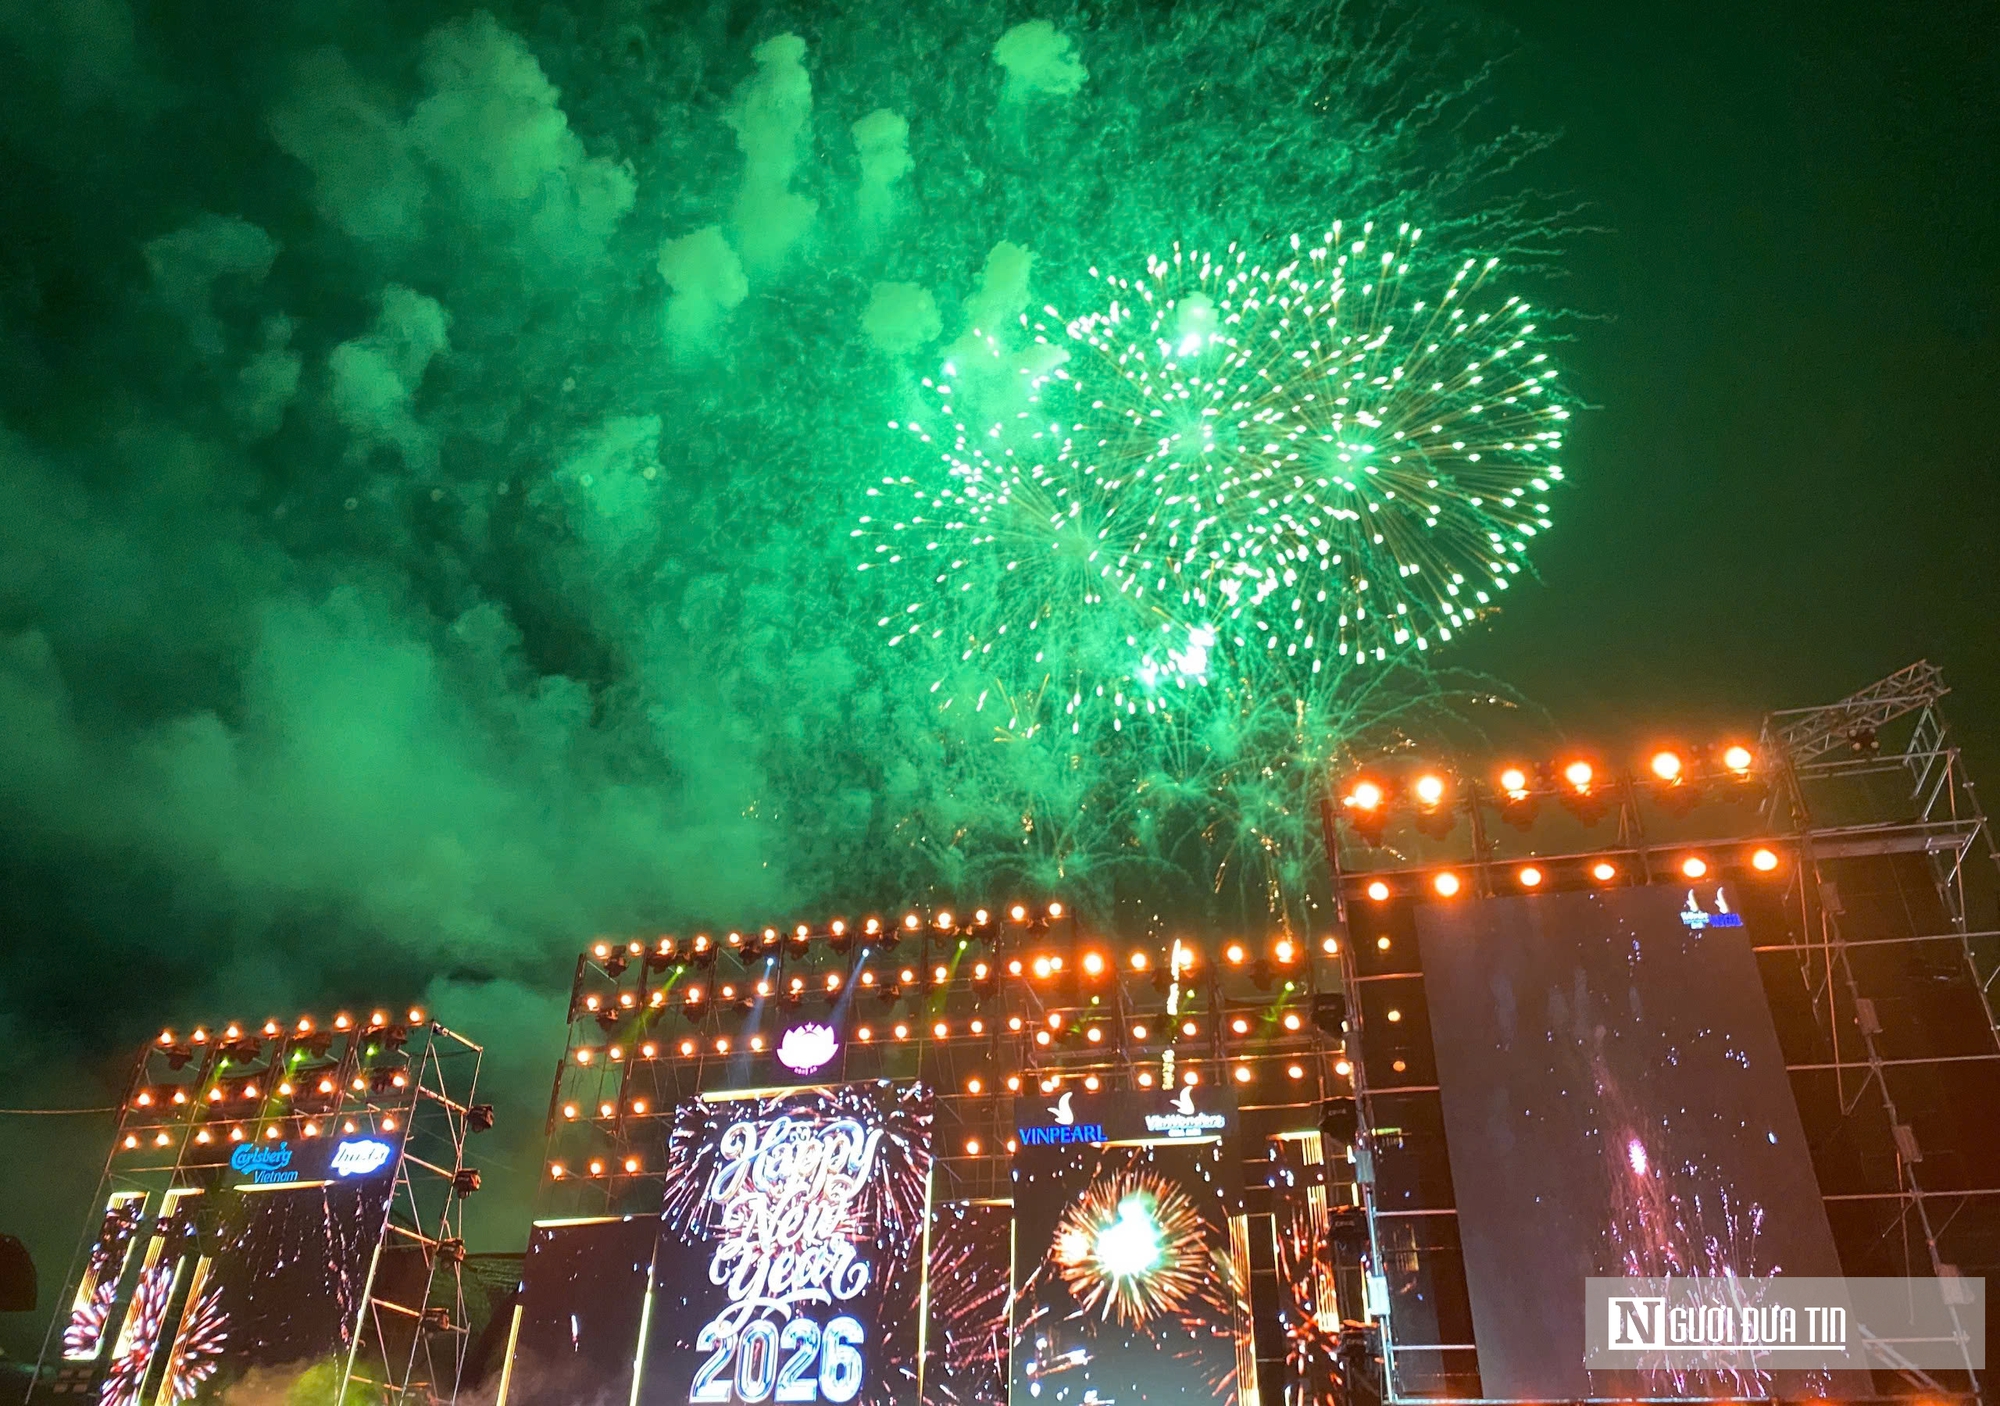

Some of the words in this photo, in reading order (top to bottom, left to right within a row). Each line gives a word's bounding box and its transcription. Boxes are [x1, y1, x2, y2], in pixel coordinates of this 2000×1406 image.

[230, 1141, 292, 1175] Carlsberg
[710, 1116, 884, 1205] Happy
[1018, 1125, 1108, 1146] VINPEARL
[253, 1170, 299, 1184] Vietnam
[722, 1187, 853, 1258] New
[708, 1236, 870, 1340] Year
[689, 1315, 866, 1404] 2026
